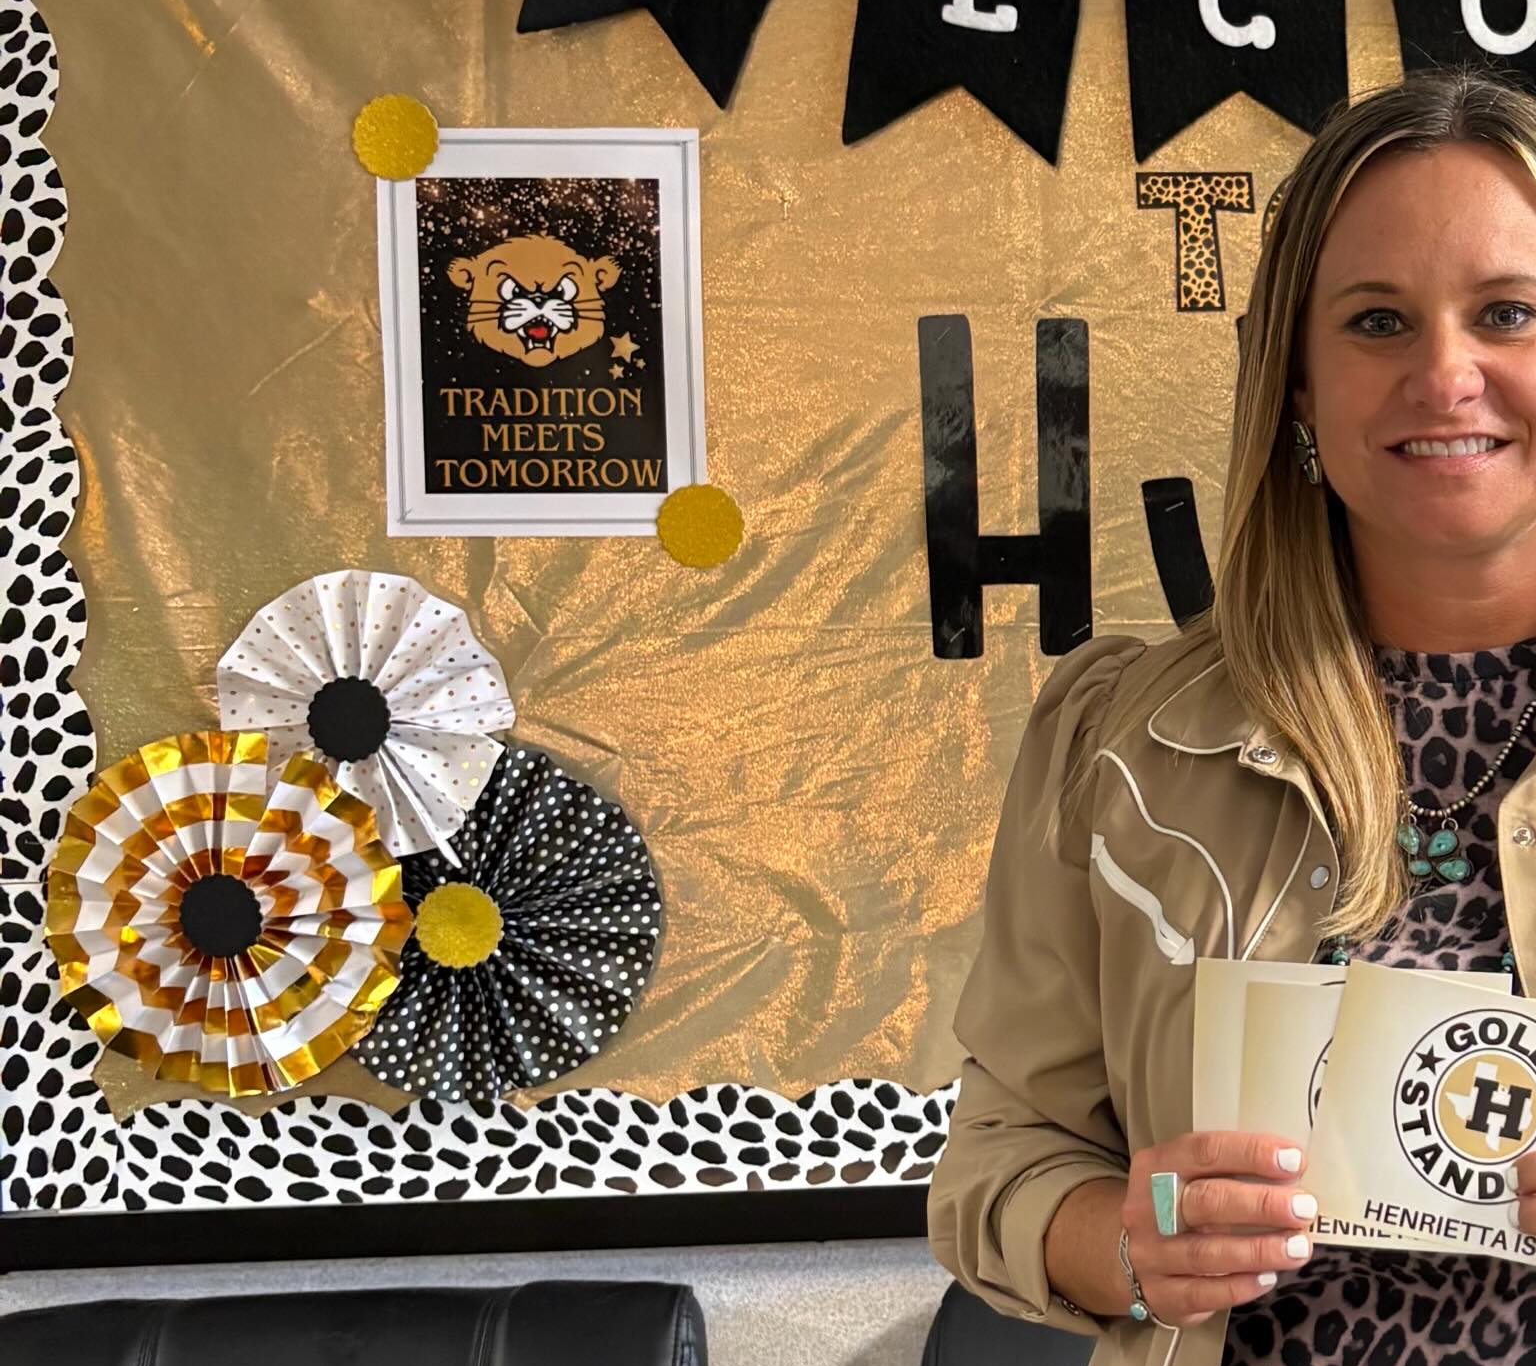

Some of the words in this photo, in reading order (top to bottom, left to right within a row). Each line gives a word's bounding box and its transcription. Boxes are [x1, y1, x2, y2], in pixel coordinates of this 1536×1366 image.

[440, 387, 643, 417] TRADITION
[483, 423, 606, 452] MEETS
[435, 458, 663, 488] TOMORROW
[1465, 1077, 1531, 1141] H
[1363, 1199, 1507, 1250] HENRIETTA
